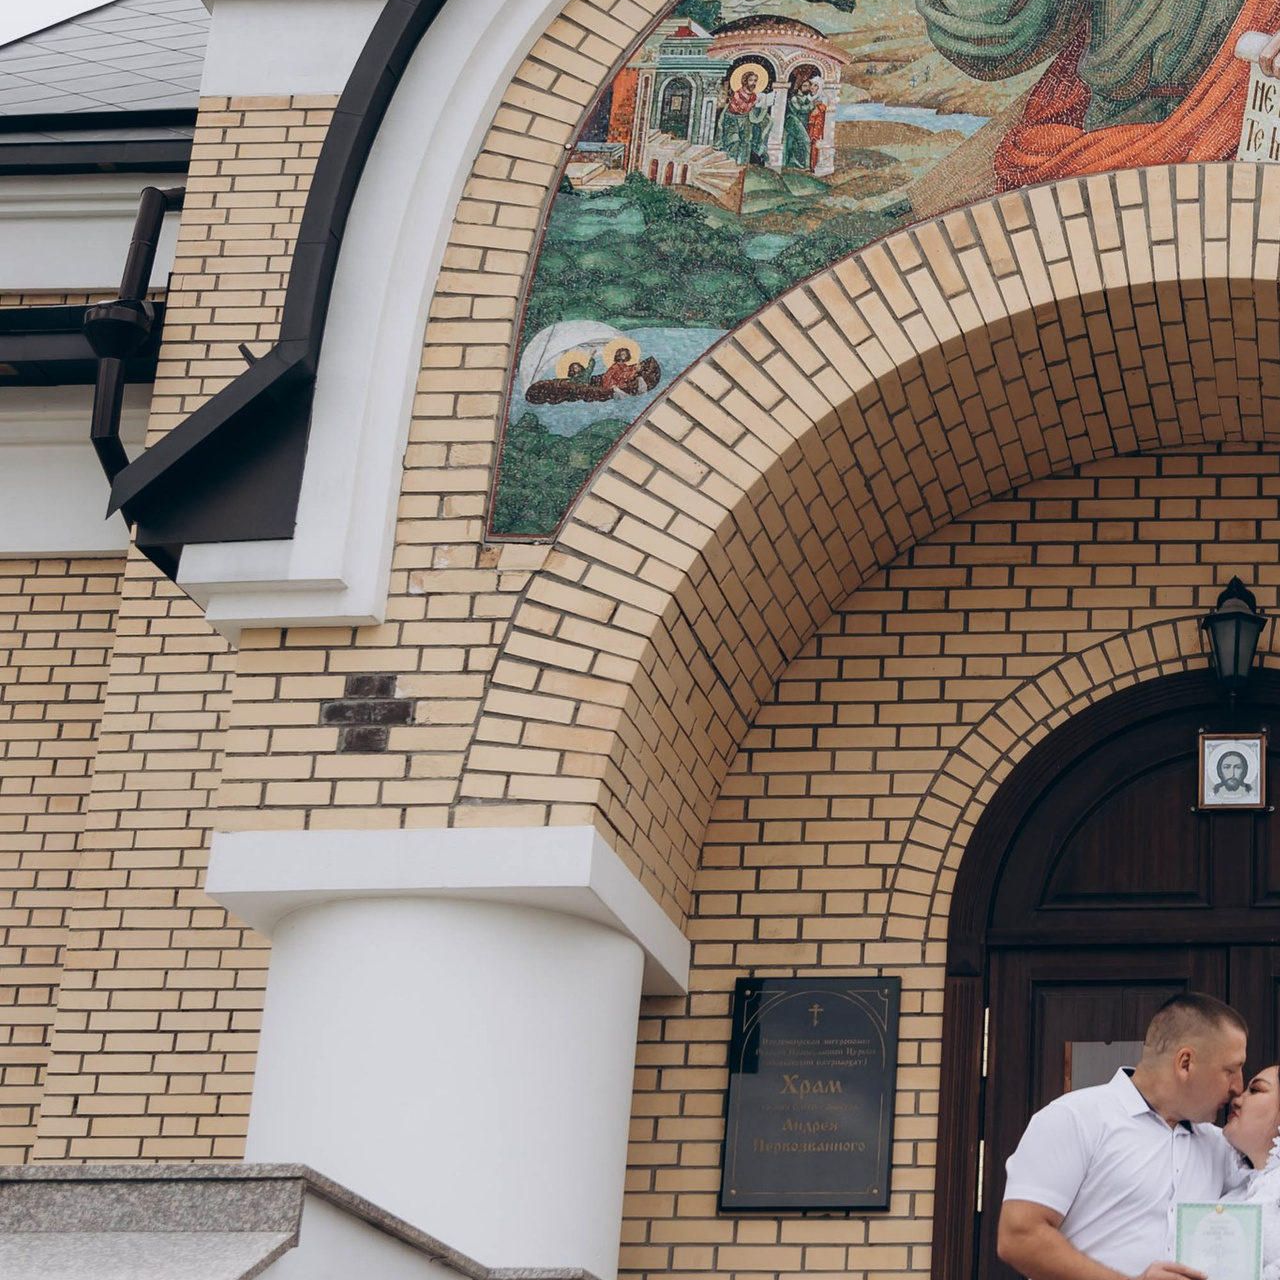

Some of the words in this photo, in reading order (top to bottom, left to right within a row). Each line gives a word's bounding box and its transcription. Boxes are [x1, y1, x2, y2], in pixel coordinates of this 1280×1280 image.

[779, 1074, 843, 1099] Храм
[781, 1118, 839, 1134] Андрея
[752, 1137, 866, 1156] Первозванного
